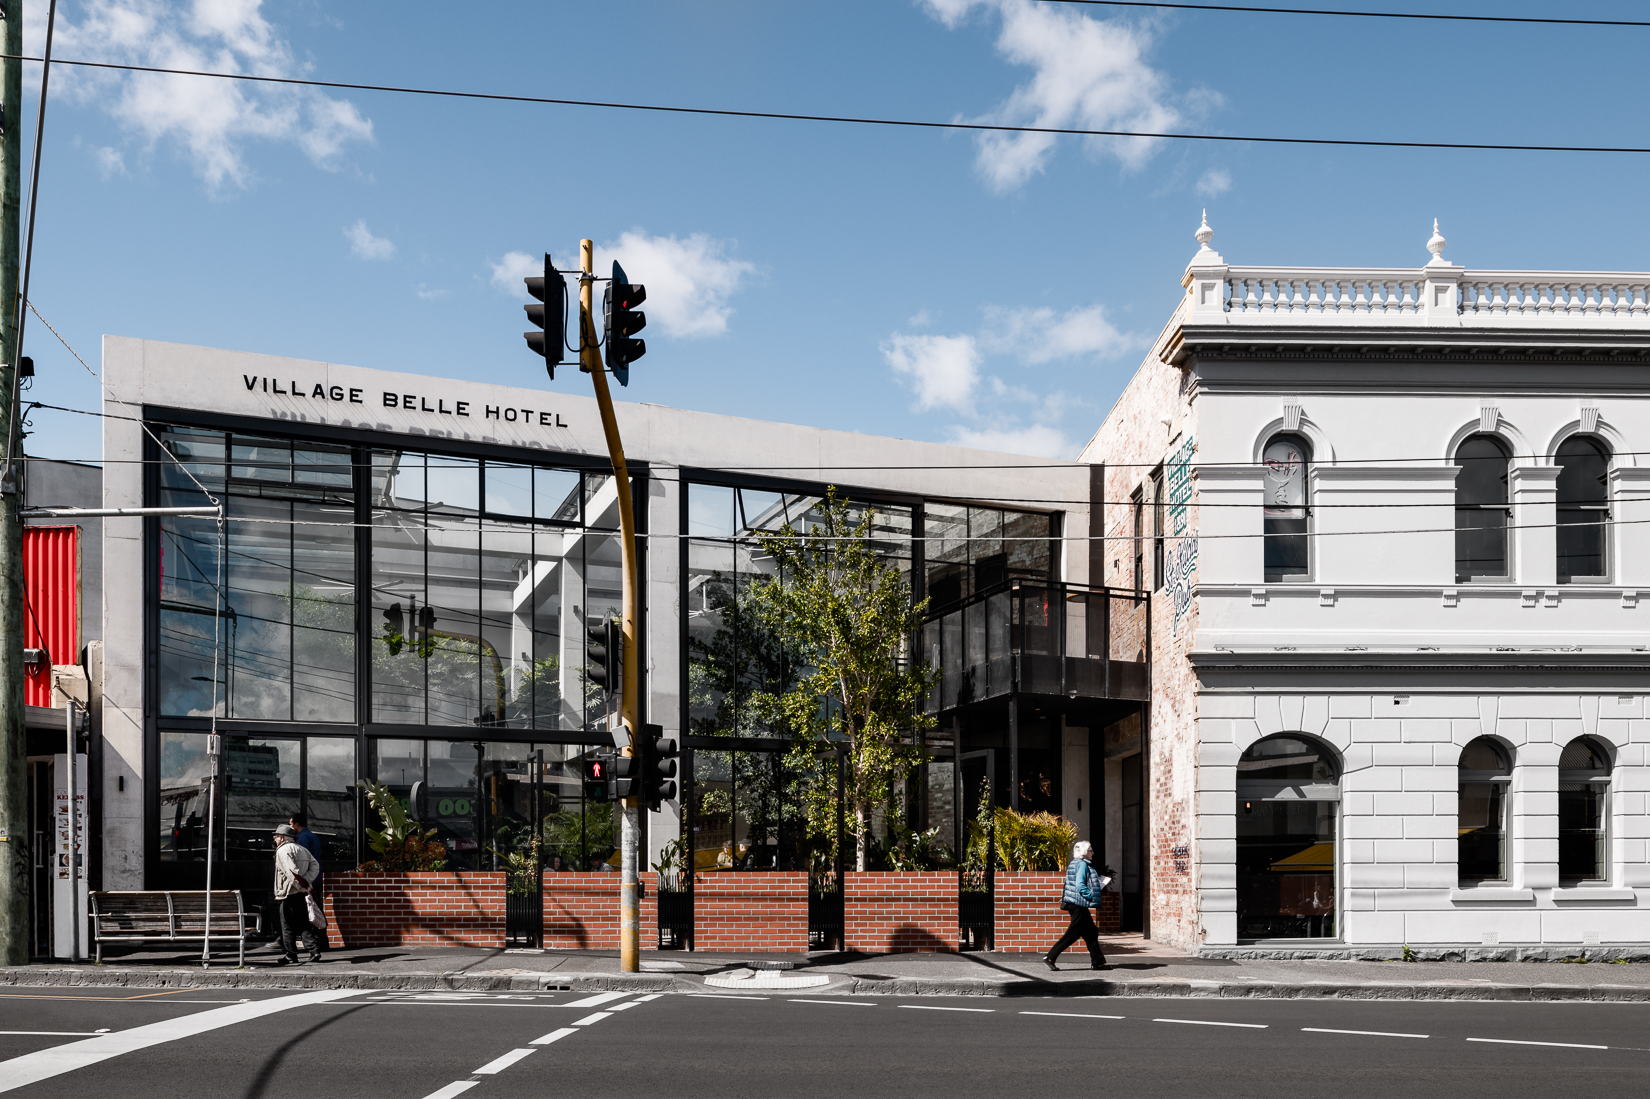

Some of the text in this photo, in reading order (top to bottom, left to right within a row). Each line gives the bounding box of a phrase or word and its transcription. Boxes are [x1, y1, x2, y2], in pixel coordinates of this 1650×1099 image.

[243, 374, 568, 428] VILLAGE BELLE HOTEL
[1167, 436, 1194, 480] VILLAGE
[1169, 461, 1190, 495] BELLE
[1170, 479, 1192, 515] HOTEL
[1173, 579, 1191, 636] Pub
